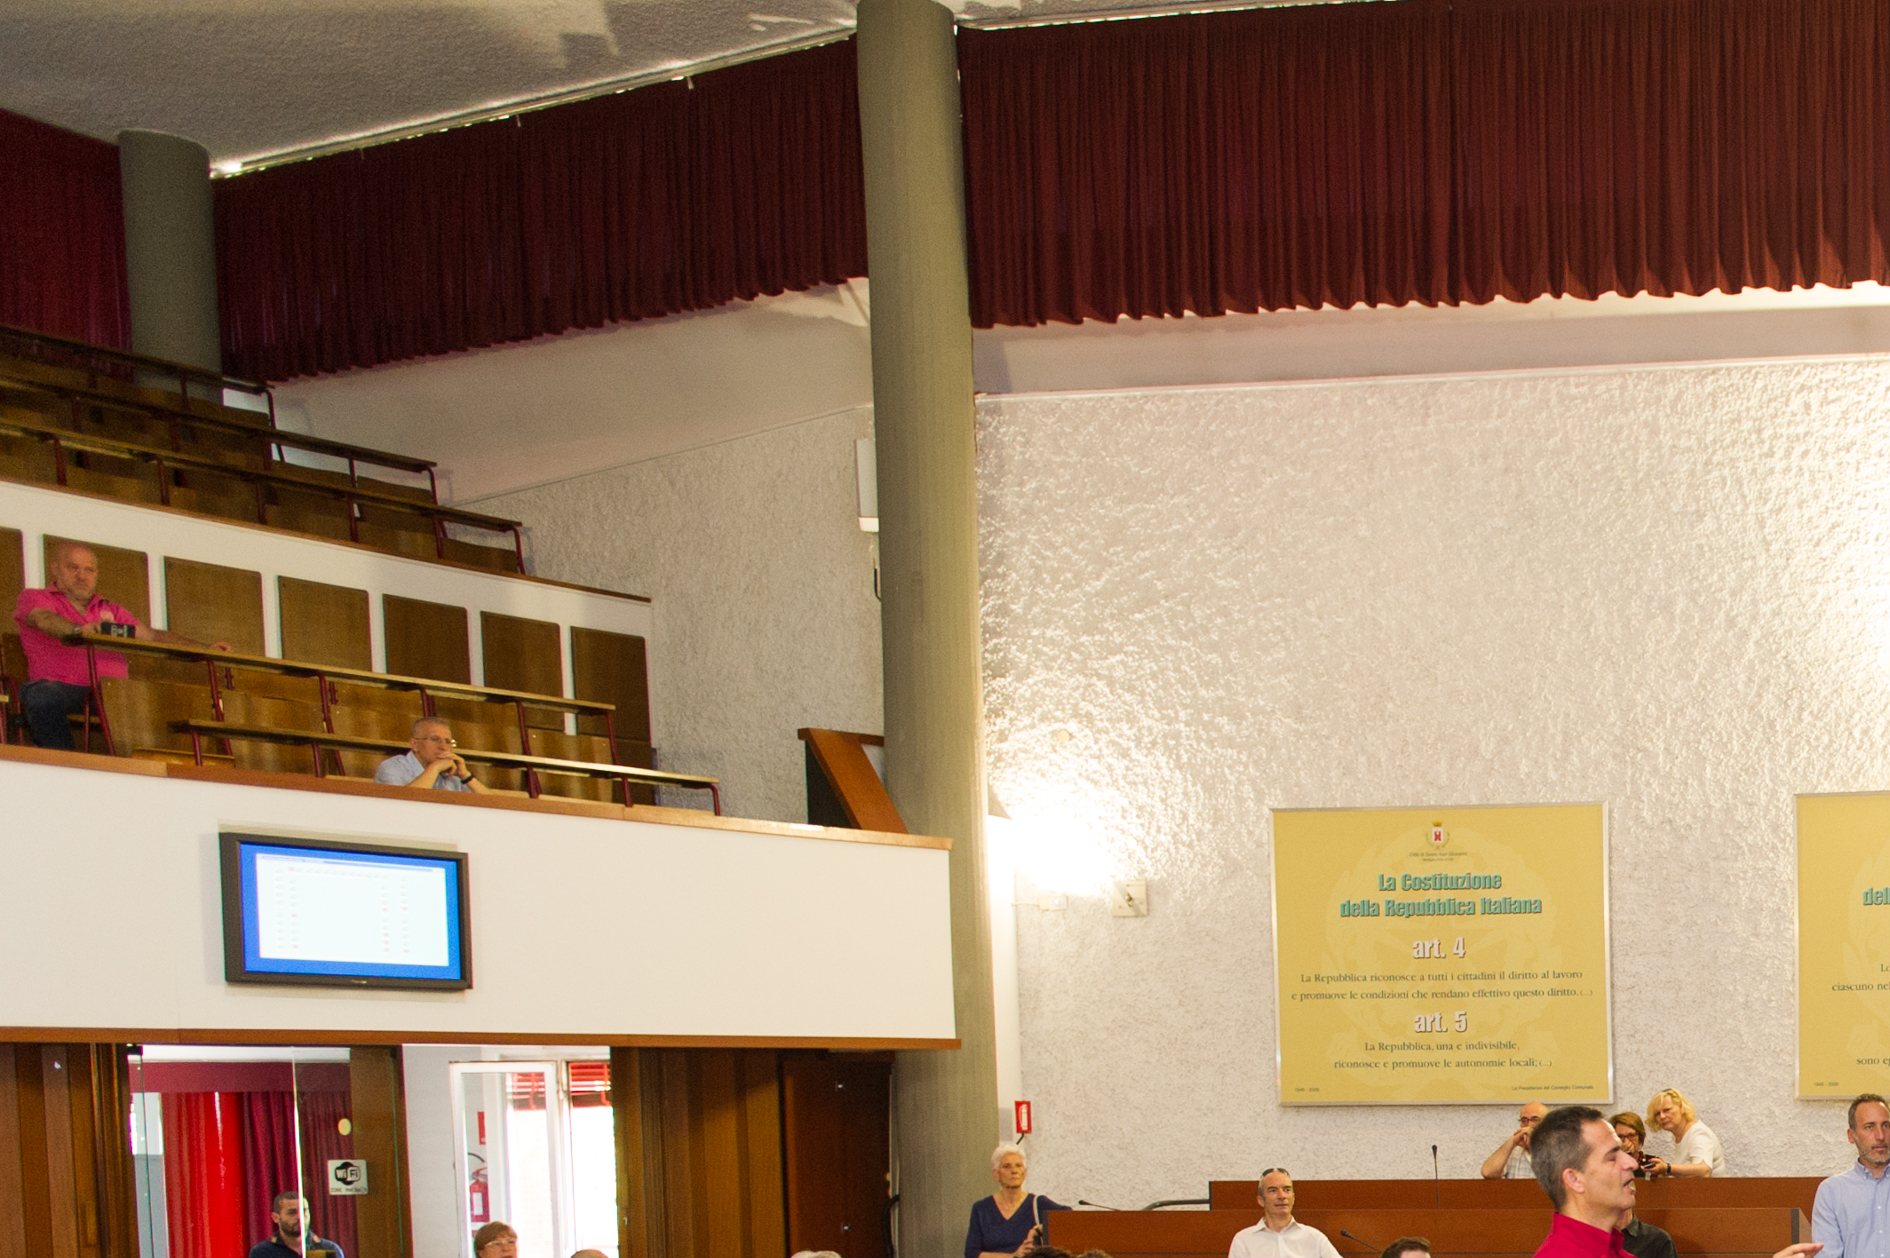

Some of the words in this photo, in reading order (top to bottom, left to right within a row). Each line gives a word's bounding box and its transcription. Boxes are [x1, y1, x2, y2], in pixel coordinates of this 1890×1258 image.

[1378, 874, 1396, 891] La
[1401, 873, 1502, 891] Costituzione
[1340, 900, 1380, 917] della
[1384, 899, 1476, 919] Repubblica
[1480, 897, 1542, 915] Italiana
[1414, 939, 1446, 959] art.
[1454, 937, 1466, 958] 4
[1301, 974, 1311, 982] La
[1315, 974, 1367, 984] Repubblica
[1428, 973, 1447, 981] tutti
[1457, 972, 1496, 980] cittadini
[1507, 971, 1540, 979] diritto
[1832, 983, 1873, 991] ciascuno
[1878, 982, 1890, 990] nel
[1300, 993, 1346, 1002] promuove
[1350, 991, 1357, 999] le
[1360, 991, 1408, 999] condizioni
[1412, 990, 1428, 998] che
[1431, 990, 1469, 998] rendano
[1513, 990, 1544, 999] questo
[1415, 1013, 1448, 1033] art.
[1455, 1011, 1467, 1033] 5
[1378, 1042, 1434, 1052] Repubblica,
[1464, 1041, 1519, 1049] indivisibile,
[1392, 1062, 1440, 1070] promuove
[1443, 1059, 1452, 1067] le
[1455, 1059, 1506, 1067] autonomie
